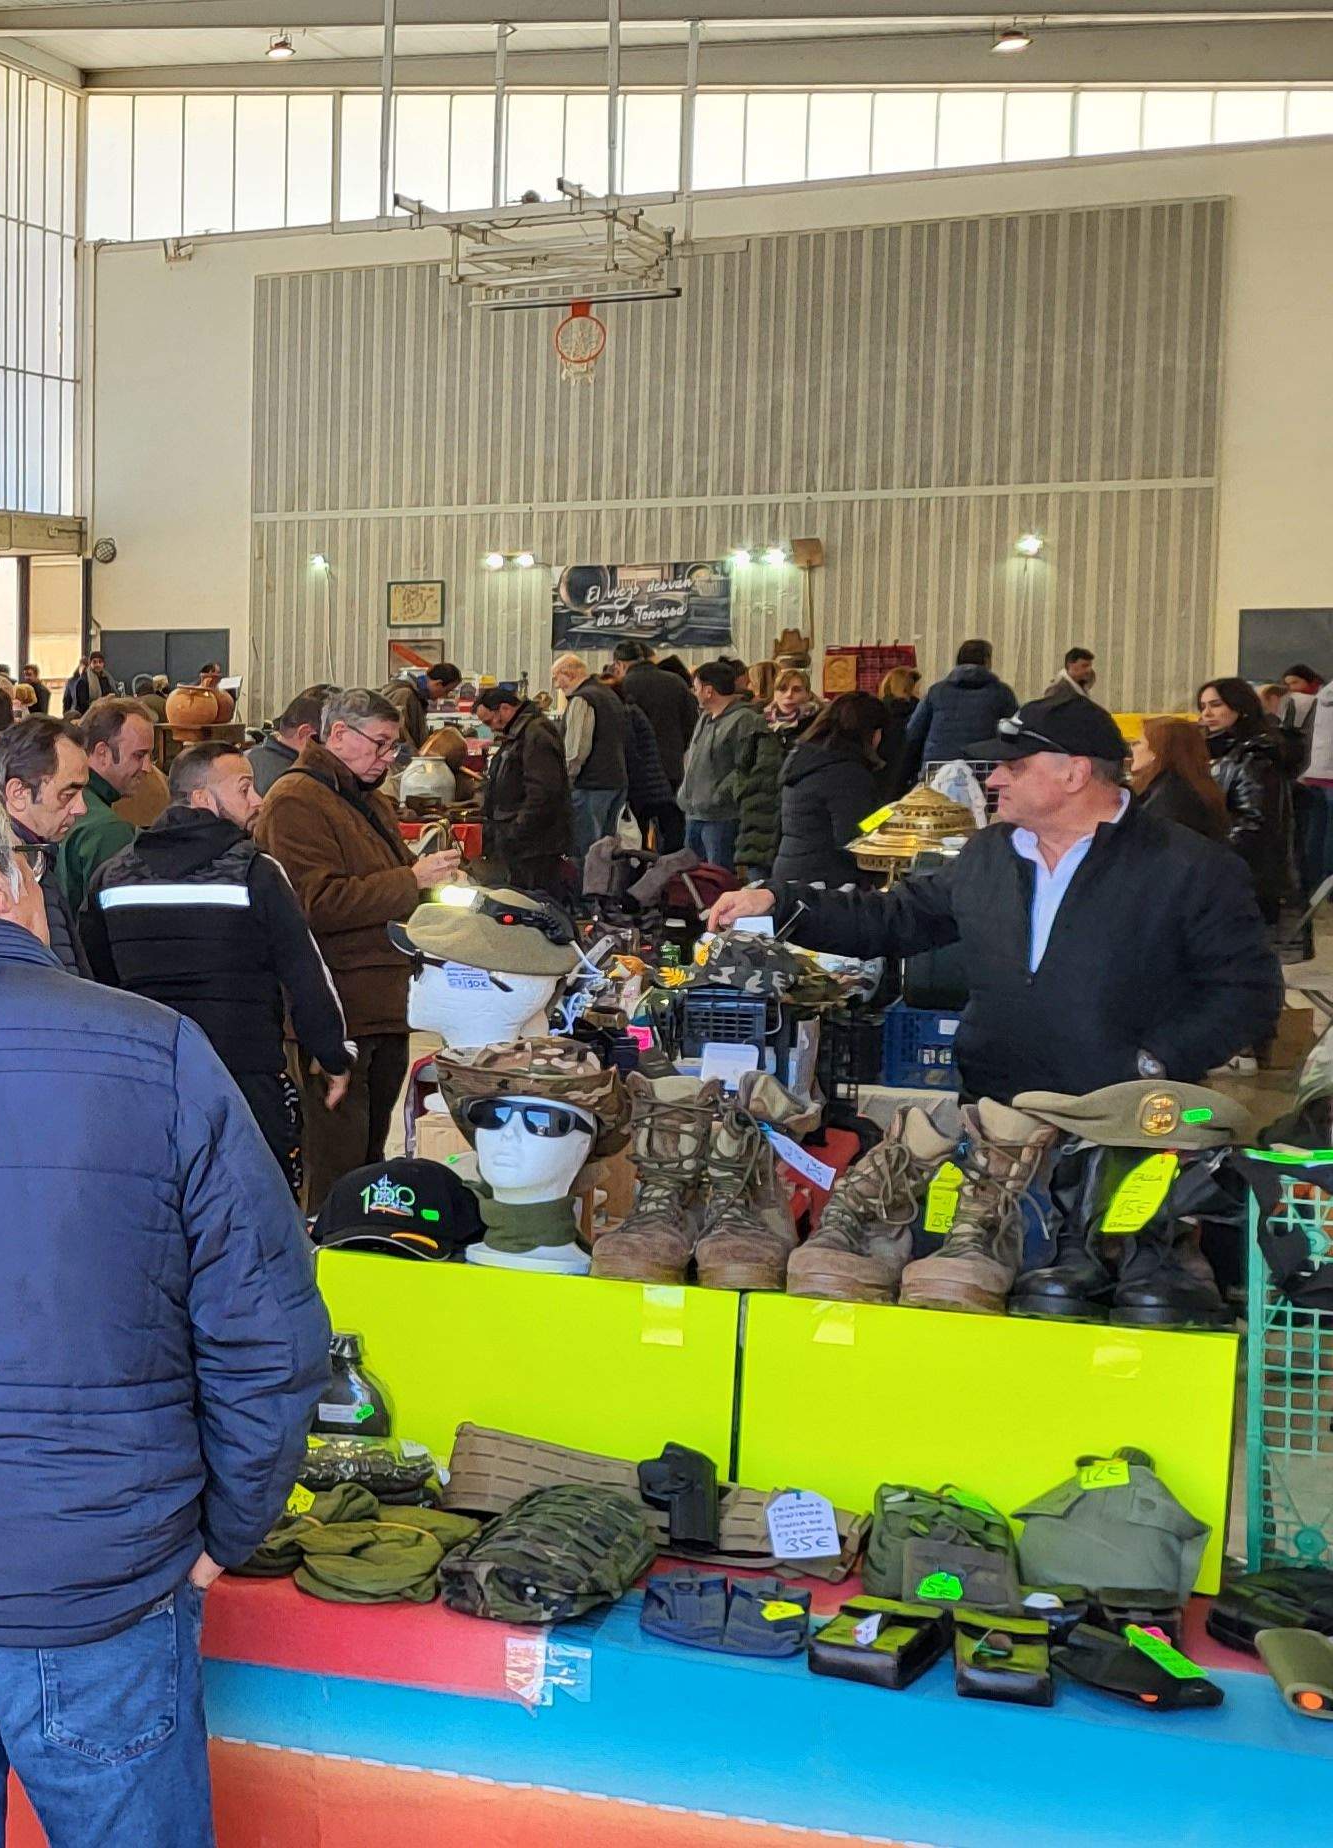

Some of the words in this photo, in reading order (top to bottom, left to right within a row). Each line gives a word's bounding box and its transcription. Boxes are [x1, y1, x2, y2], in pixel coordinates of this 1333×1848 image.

[586, 585, 601, 604] El
[604, 583, 640, 610] viejo
[647, 575, 693, 593] desván
[597, 612, 613, 627] de
[615, 610, 629, 626] la
[784, 1535, 830, 1552] 35€
